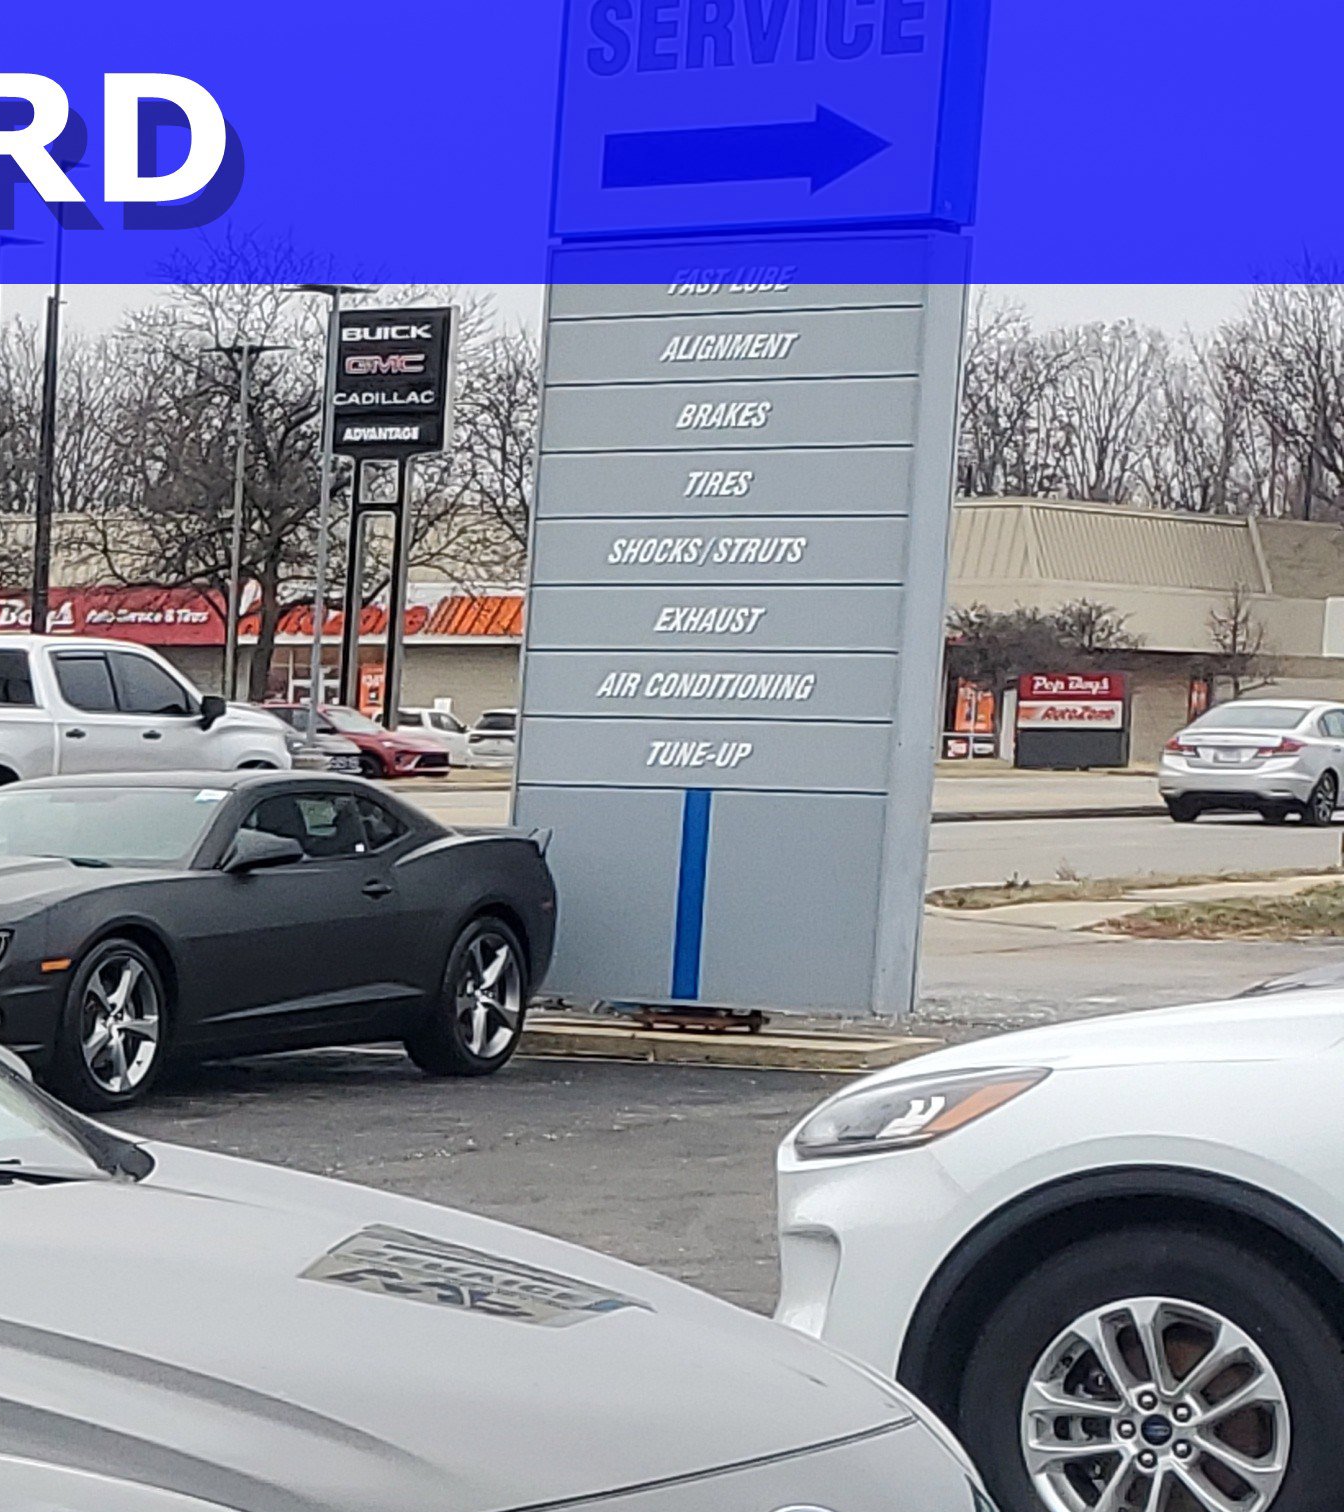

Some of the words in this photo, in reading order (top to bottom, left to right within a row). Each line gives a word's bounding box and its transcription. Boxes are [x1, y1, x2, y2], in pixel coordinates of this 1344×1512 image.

[667, 268, 730, 296] FAST
[729, 264, 797, 294] LUBE
[341, 324, 432, 341] BUICK
[659, 332, 800, 362] ALIGNMENT
[345, 353, 426, 375] GMC
[332, 389, 435, 406] CADILLAC
[675, 401, 772, 430] BRAKES
[342, 426, 420, 441] ADVANTAGE
[683, 470, 755, 498] TIRES
[653, 606, 766, 633] EXHAUST
[595, 672, 642, 698] AIR
[644, 672, 816, 700] CONDITIONING
[1032, 675, 1065, 692] Pep
[1068, 676, 1111, 693] Boys
[1041, 705, 1115, 722] AutoZone
[645, 741, 754, 767] TUNE-UP
